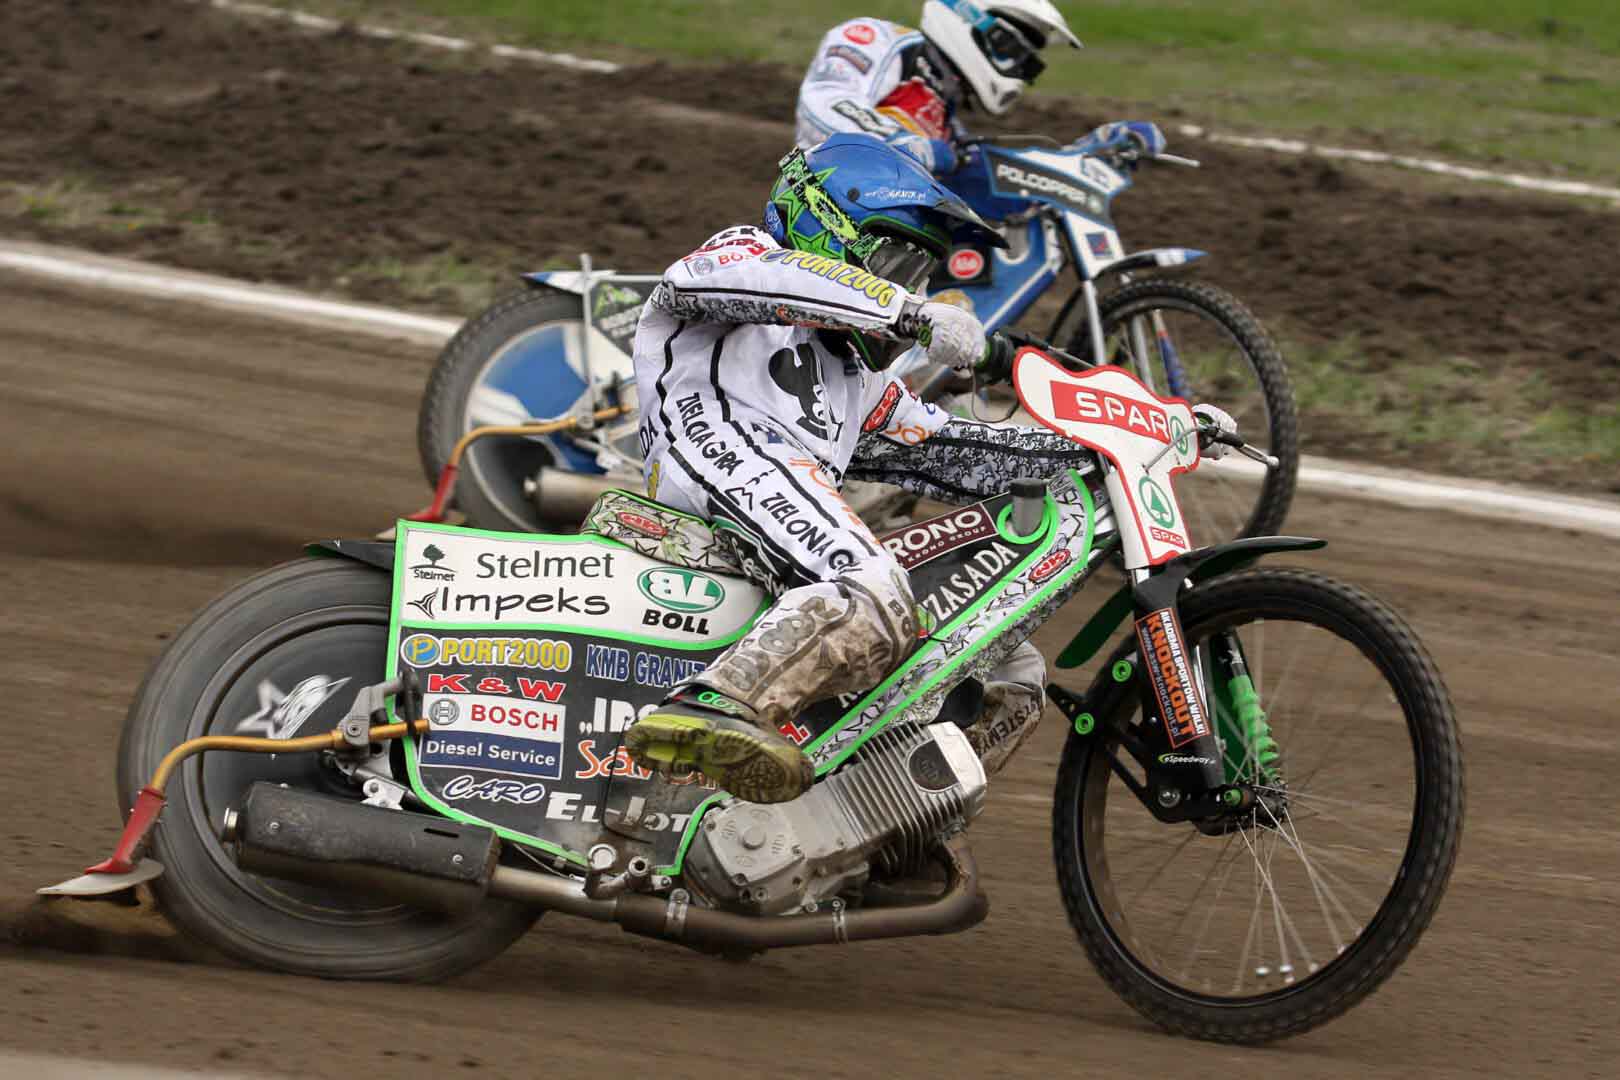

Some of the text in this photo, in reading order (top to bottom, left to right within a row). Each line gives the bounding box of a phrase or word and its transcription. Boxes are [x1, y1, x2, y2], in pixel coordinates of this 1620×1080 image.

[1075, 391, 1170, 439] SPAR
[760, 492, 835, 557] ZIELONA
[881, 510, 983, 559] RONO
[476, 550, 614, 578] Stelmet
[925, 542, 1019, 622] ZASADA
[442, 587, 610, 620] Impeks
[642, 609, 709, 635] BOLL
[440, 638, 572, 671] PORT2000
[586, 644, 630, 681] KMB
[427, 673, 566, 702] K & W
[1146, 614, 1196, 736] KNOCKOUT
[471, 704, 558, 732] BOSCH
[426, 740, 483, 757] Diesel
[488, 745, 555, 766] Service
